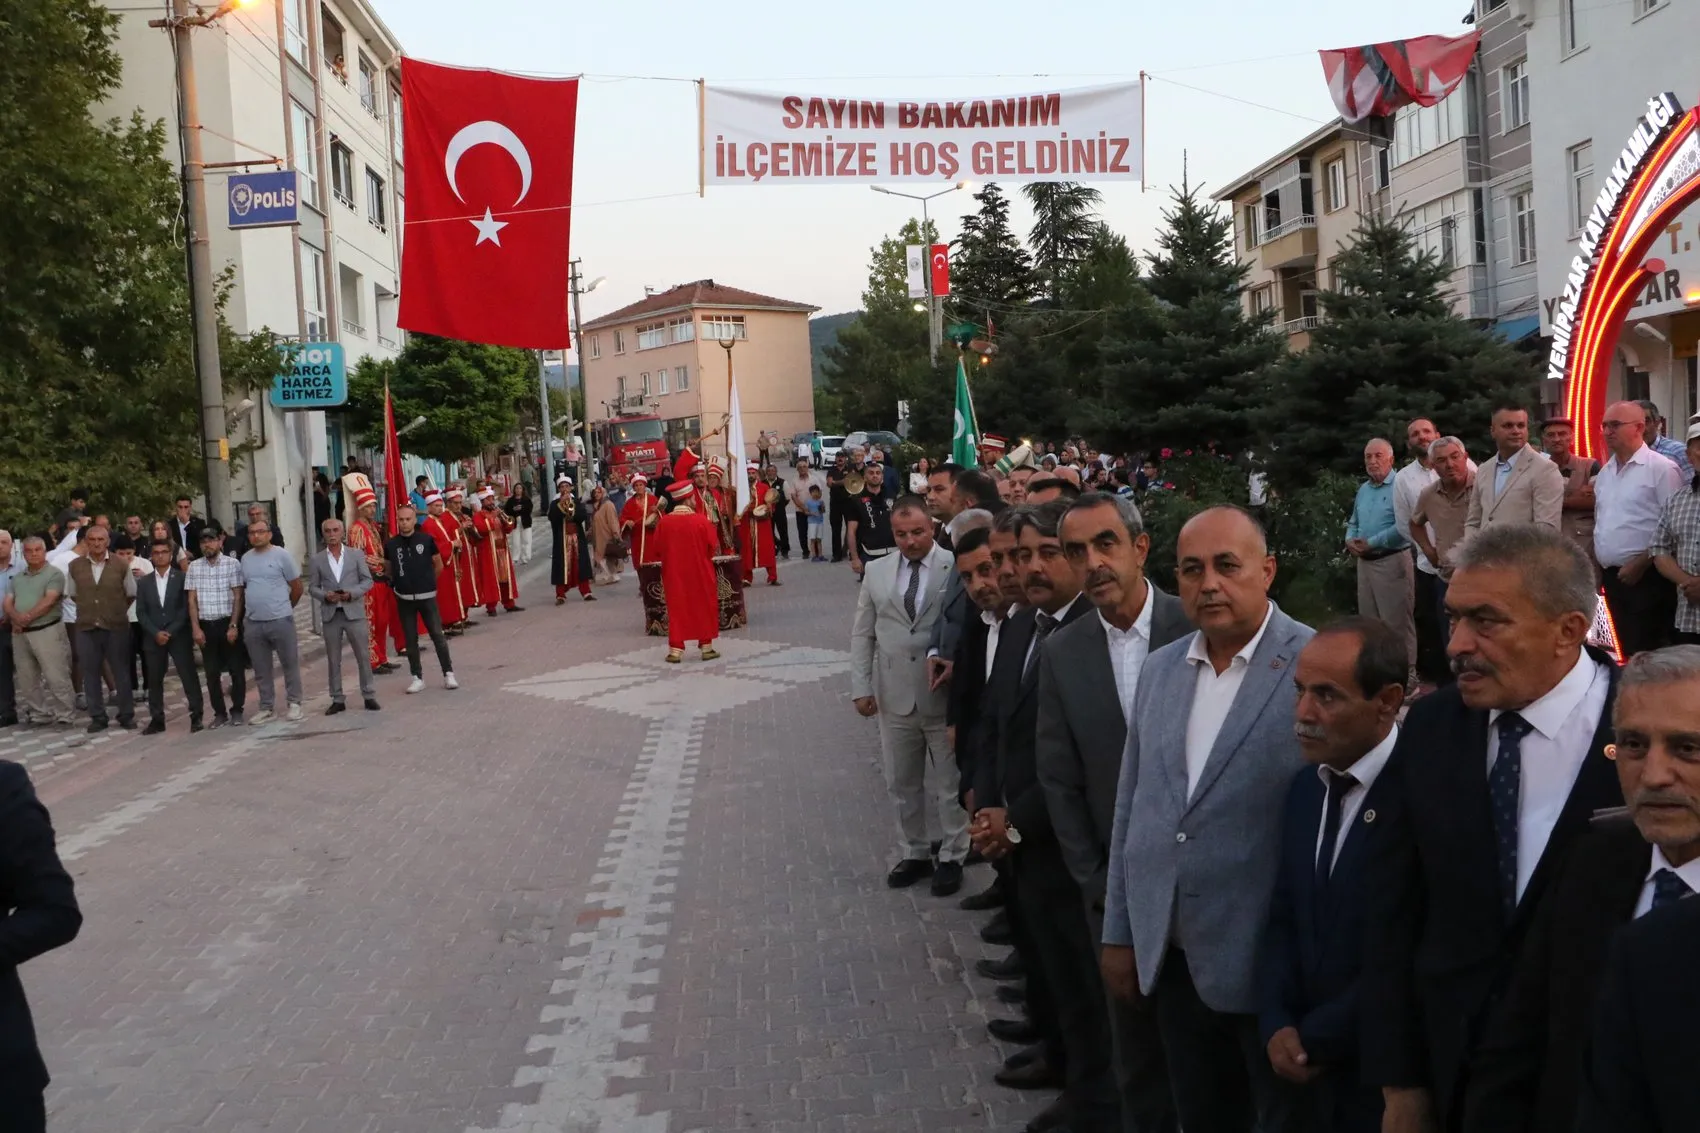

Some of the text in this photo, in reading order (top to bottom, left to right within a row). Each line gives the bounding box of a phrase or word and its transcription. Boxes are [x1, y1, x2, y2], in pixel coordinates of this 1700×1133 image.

[782, 93, 1060, 129] SAYIN BAKANIM
[716, 131, 1130, 182] İLÇEMİZE HOŞ GELDİNİZ
[254, 188, 295, 209] POLİS
[1547, 255, 1589, 380] YENİPAZAR
[1579, 92, 1675, 260] KAYMAKAMLIĞI
[1666, 222, 1700, 254] T.
[281, 377, 332, 388] HARCA
[292, 365, 331, 376] ARCA
